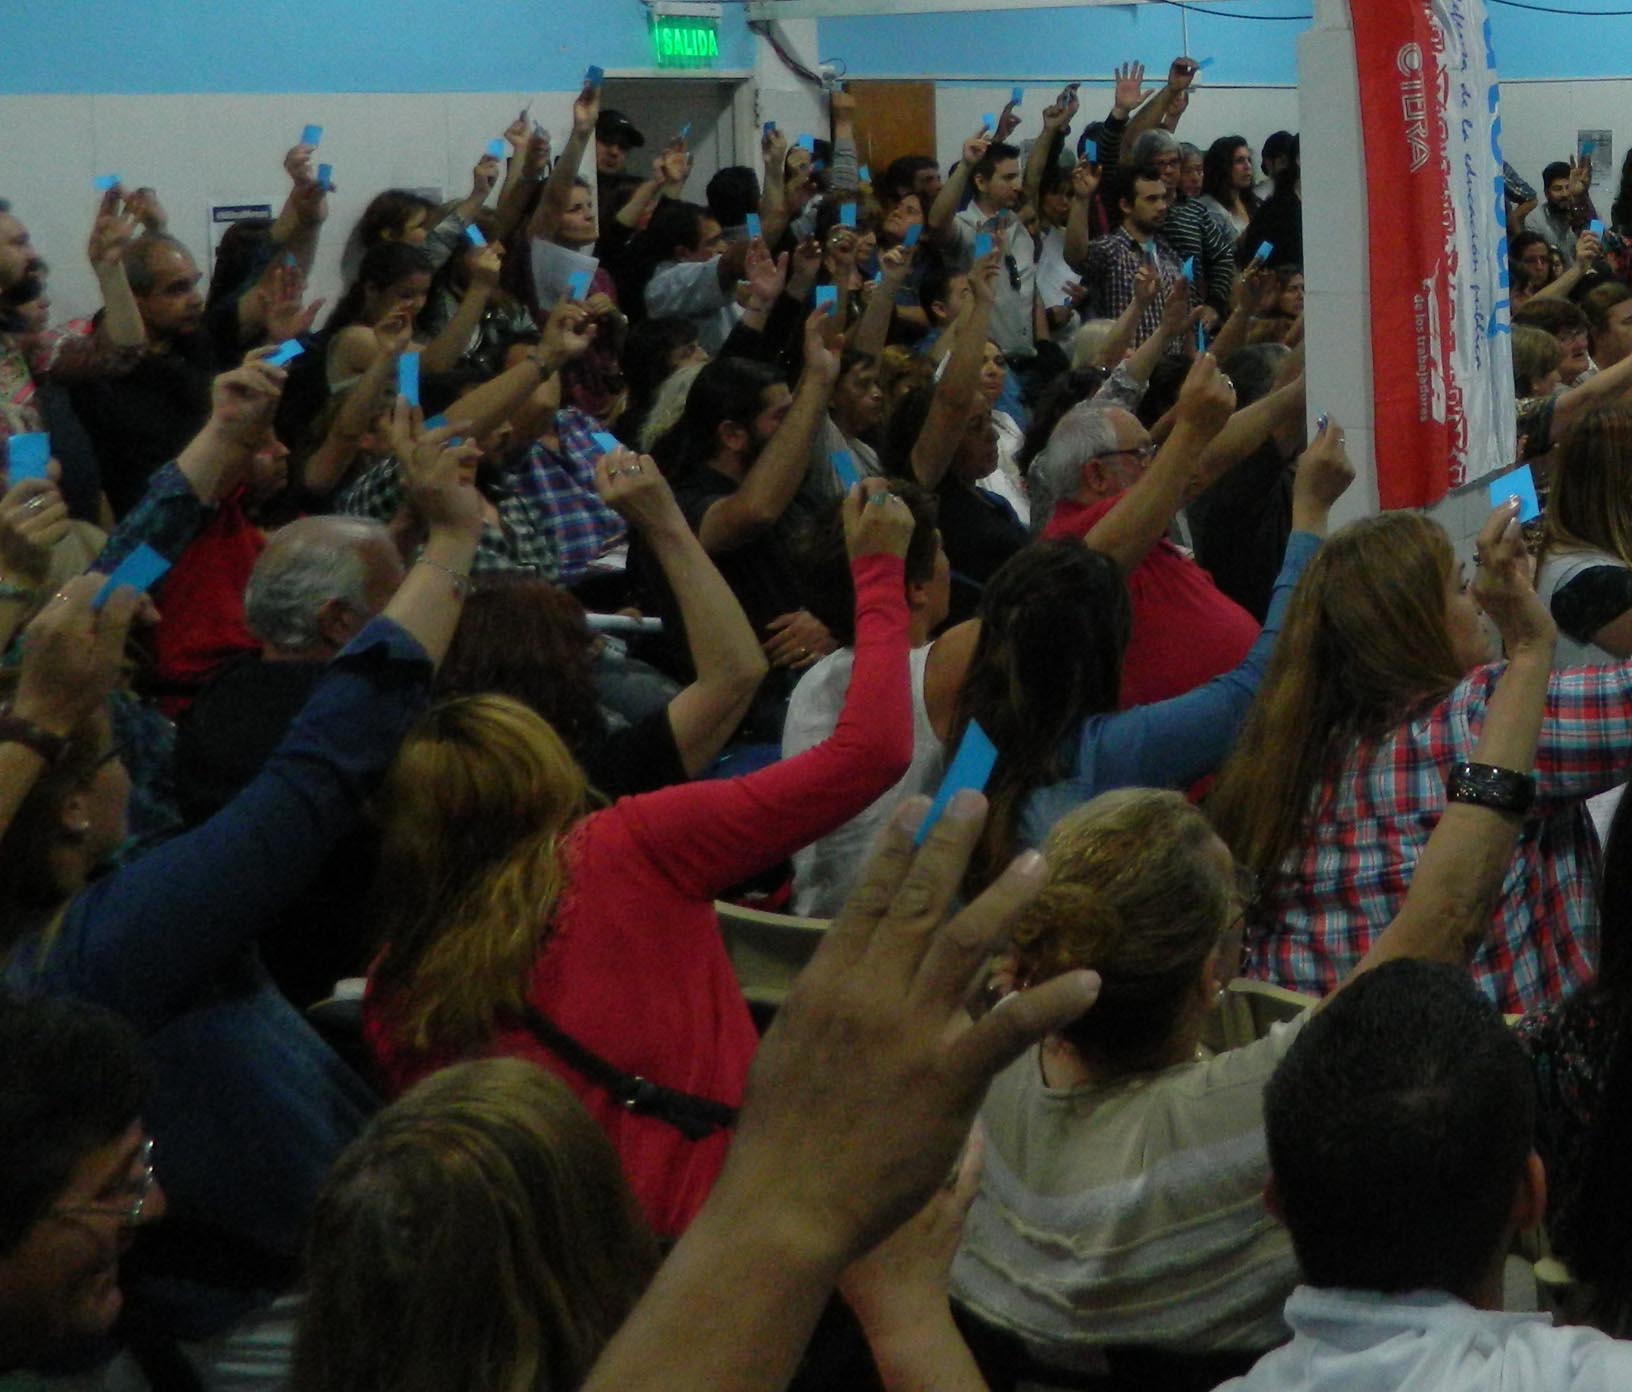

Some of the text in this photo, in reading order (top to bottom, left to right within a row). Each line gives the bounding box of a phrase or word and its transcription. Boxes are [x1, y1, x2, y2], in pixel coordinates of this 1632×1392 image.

[663, 28, 718, 56] SALIDA
[1397, 43, 1431, 172] CTERA
[1414, 294, 1429, 422] de los trabajadores
